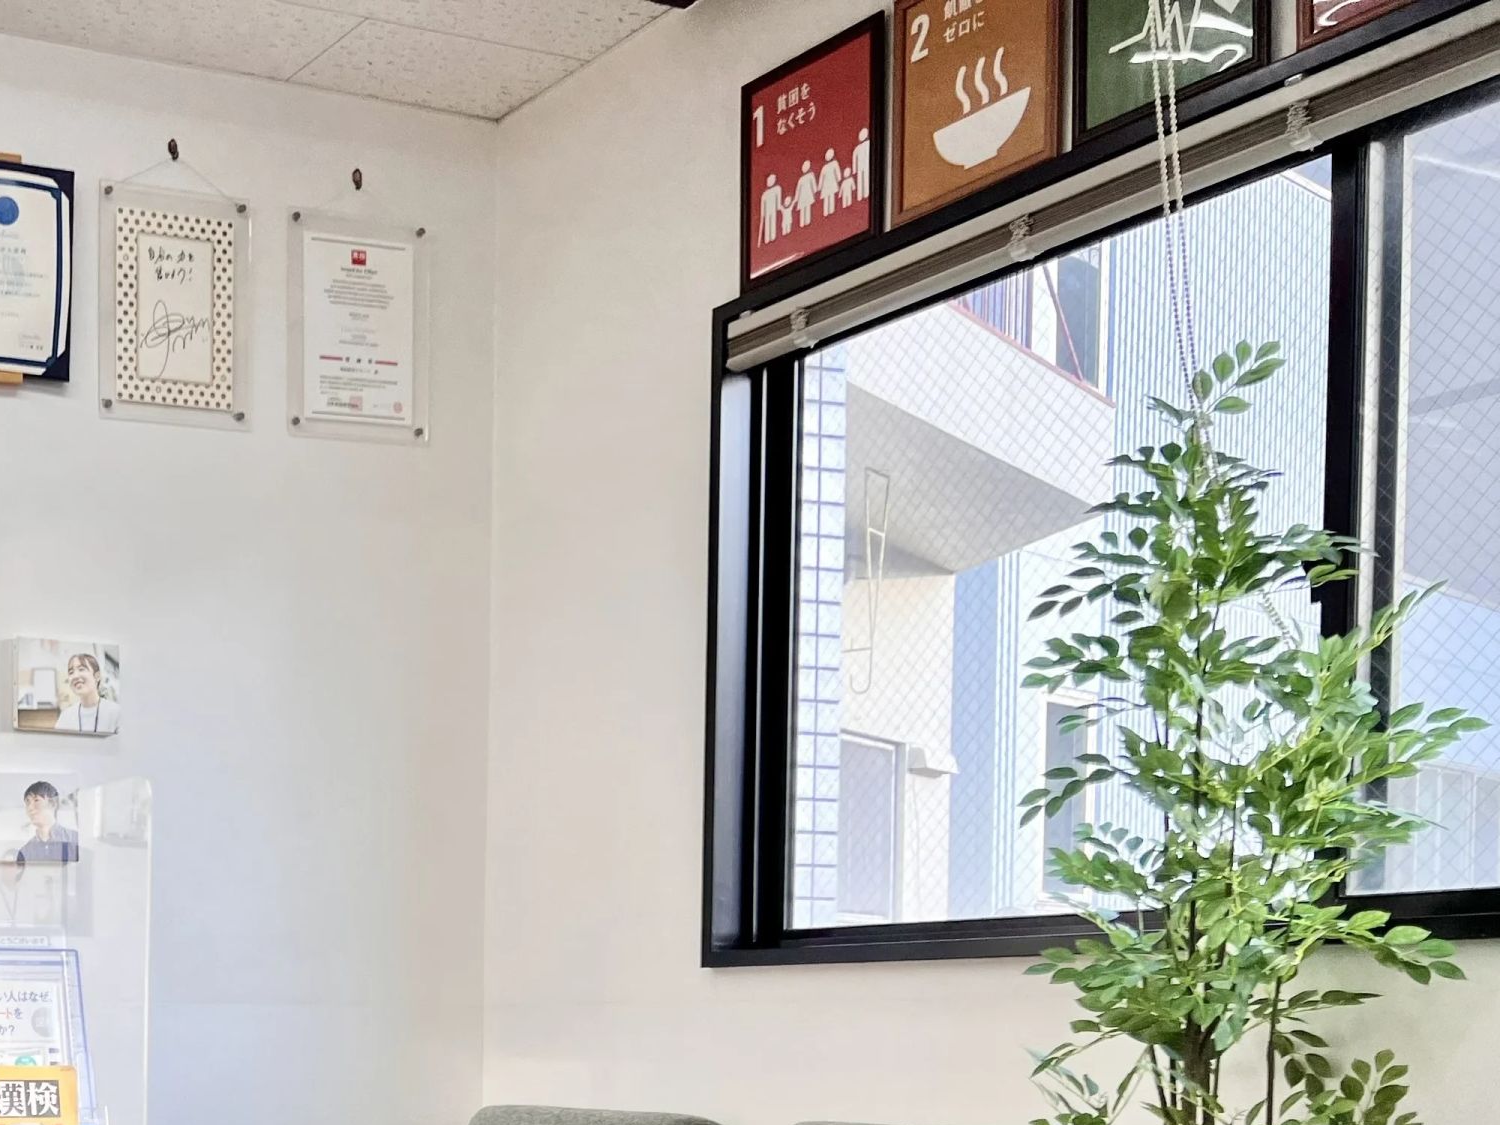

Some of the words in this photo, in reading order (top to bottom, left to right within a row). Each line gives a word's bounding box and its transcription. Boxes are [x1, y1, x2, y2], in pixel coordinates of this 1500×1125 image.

[910, 14, 930, 64] 2
[943, 11, 985, 43] ゼロに
[752, 105, 764, 148] 1
[776, 101, 816, 136] なくそう
